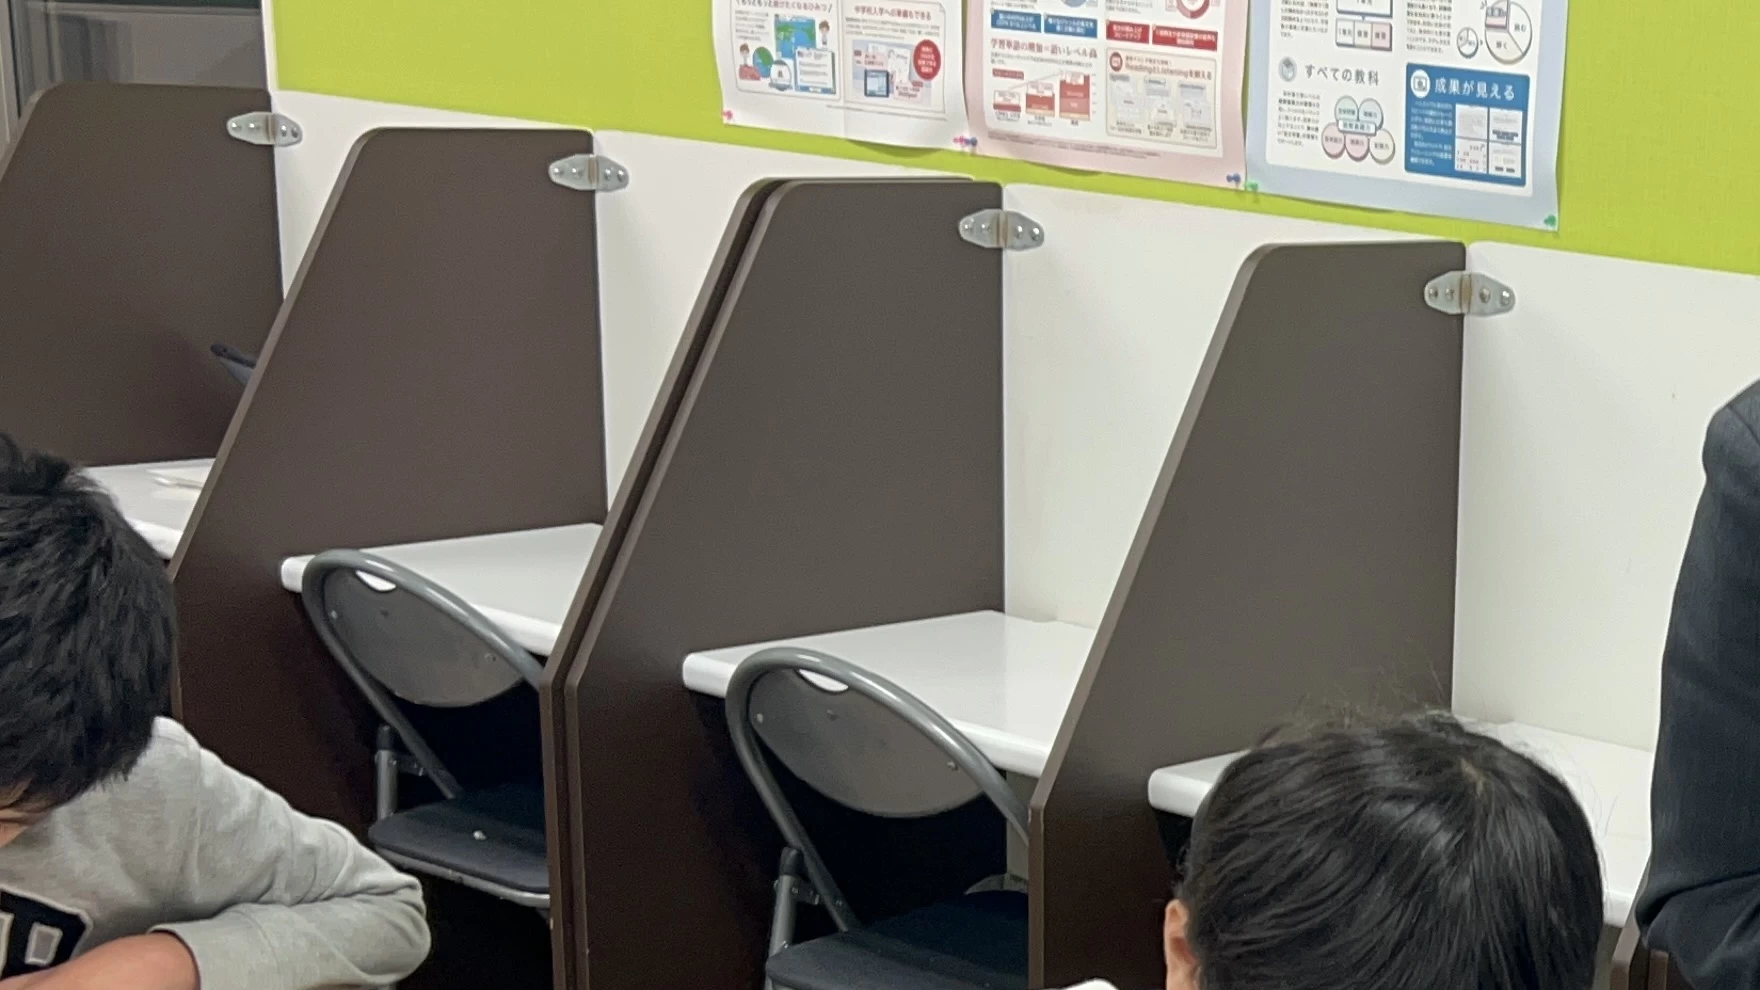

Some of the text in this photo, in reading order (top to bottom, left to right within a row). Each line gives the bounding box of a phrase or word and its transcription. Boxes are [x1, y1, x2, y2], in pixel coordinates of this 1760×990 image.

[1304, 62, 1380, 87] すべての教科
[1434, 77, 1516, 101] 成果が見える
